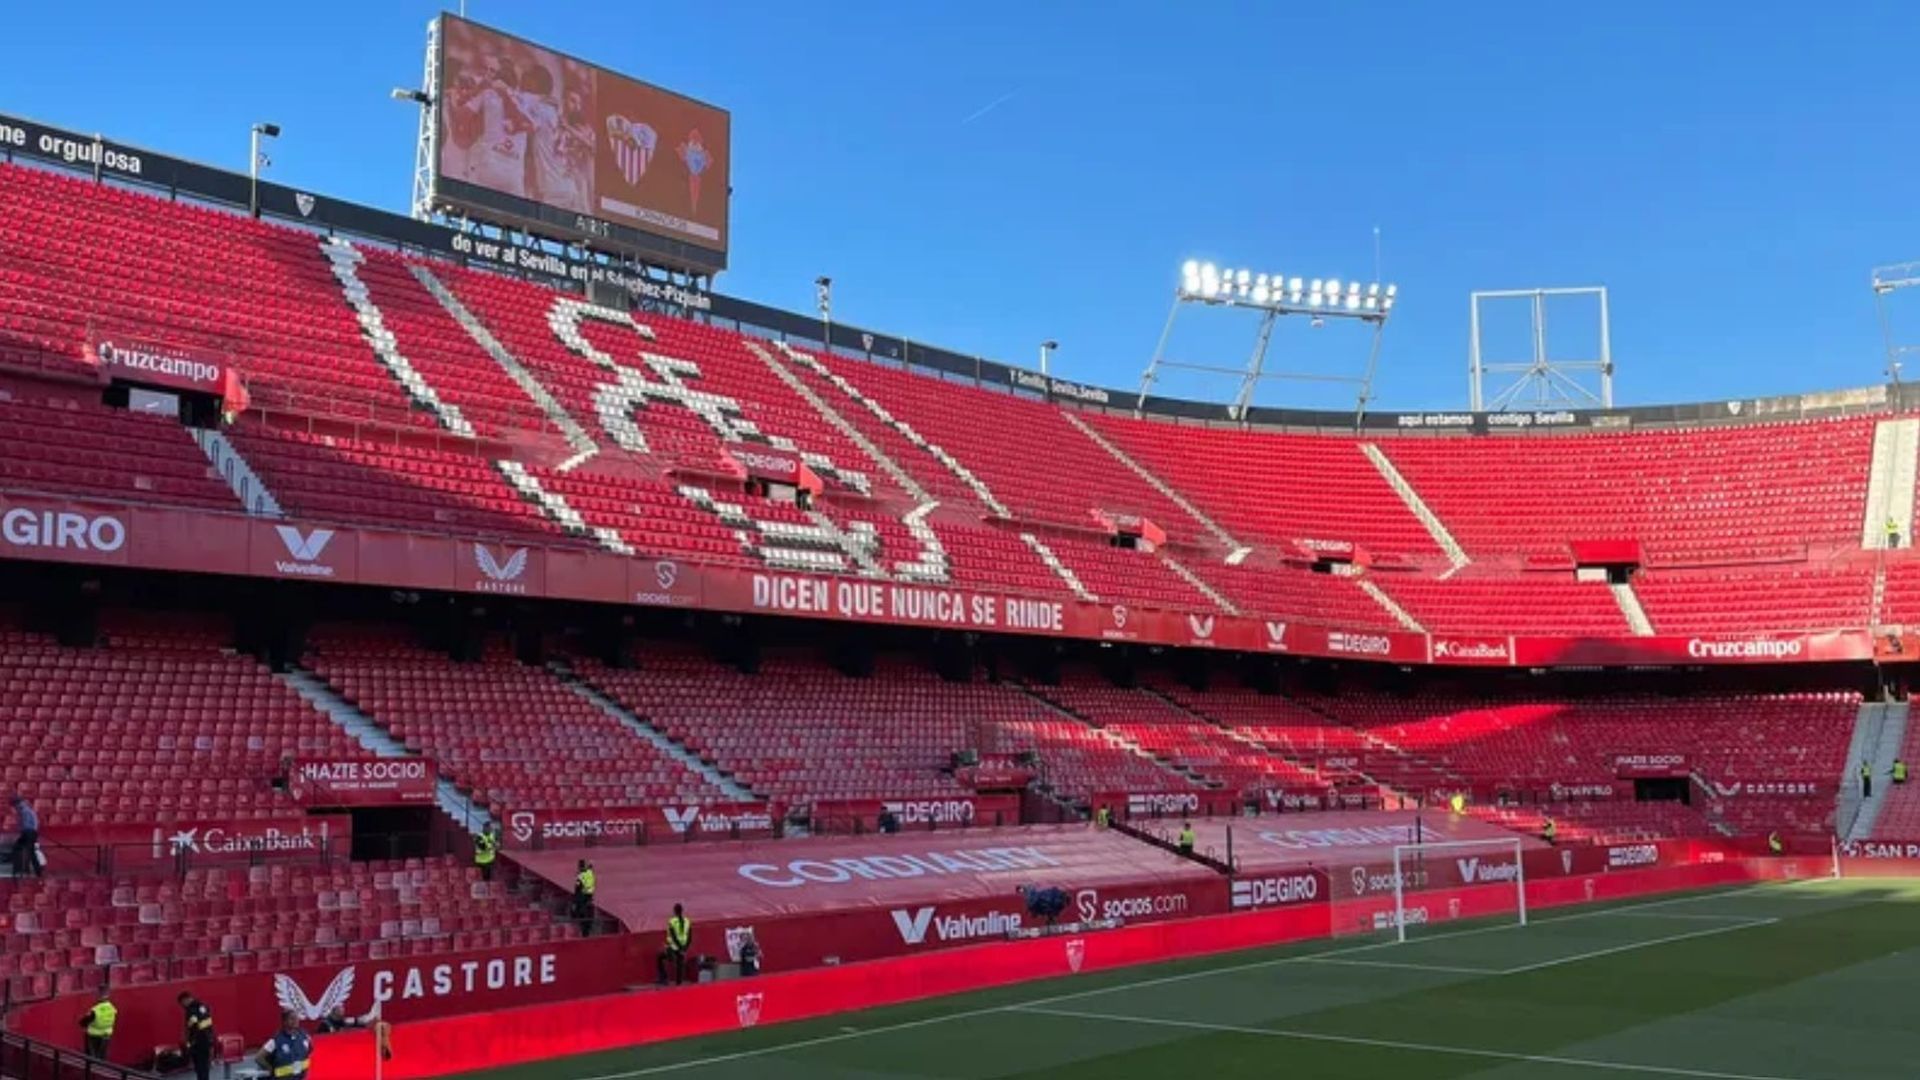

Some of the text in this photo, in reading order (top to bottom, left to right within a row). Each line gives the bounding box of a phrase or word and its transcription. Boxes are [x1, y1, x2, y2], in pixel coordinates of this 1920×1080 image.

[39, 134, 141, 174] orgullosa
[451, 232, 472, 253] de
[475, 241, 500, 259] ver
[502, 246, 516, 263] al
[519, 249, 566, 276] Sevilla
[99, 341, 220, 382] Cruzcampo
[1425, 413, 1474, 426] estamos
[1487, 413, 1531, 427] contigo
[1534, 411, 1575, 424] Sevilla
[746, 452, 796, 473] DEGIRO
[2, 508, 126, 551] GIRO
[753, 575, 1064, 630] DICEN QUE NUNCA SE RINDE
[1344, 634, 1390, 654] DEGIRO
[1450, 641, 1509, 657] CaixaBank
[1688, 637, 1801, 658] Cruzcampo
[300, 761, 426, 783] ¡HAZTE SOCIO!
[903, 800, 974, 823] DEGIRO
[203, 827, 314, 854] CaixaBank
[1864, 842, 1902, 858] SAN
[1252, 874, 1318, 905] DEGIRO
[934, 910, 1022, 941] Valvoline
[373, 953, 556, 1002] CASTORE
